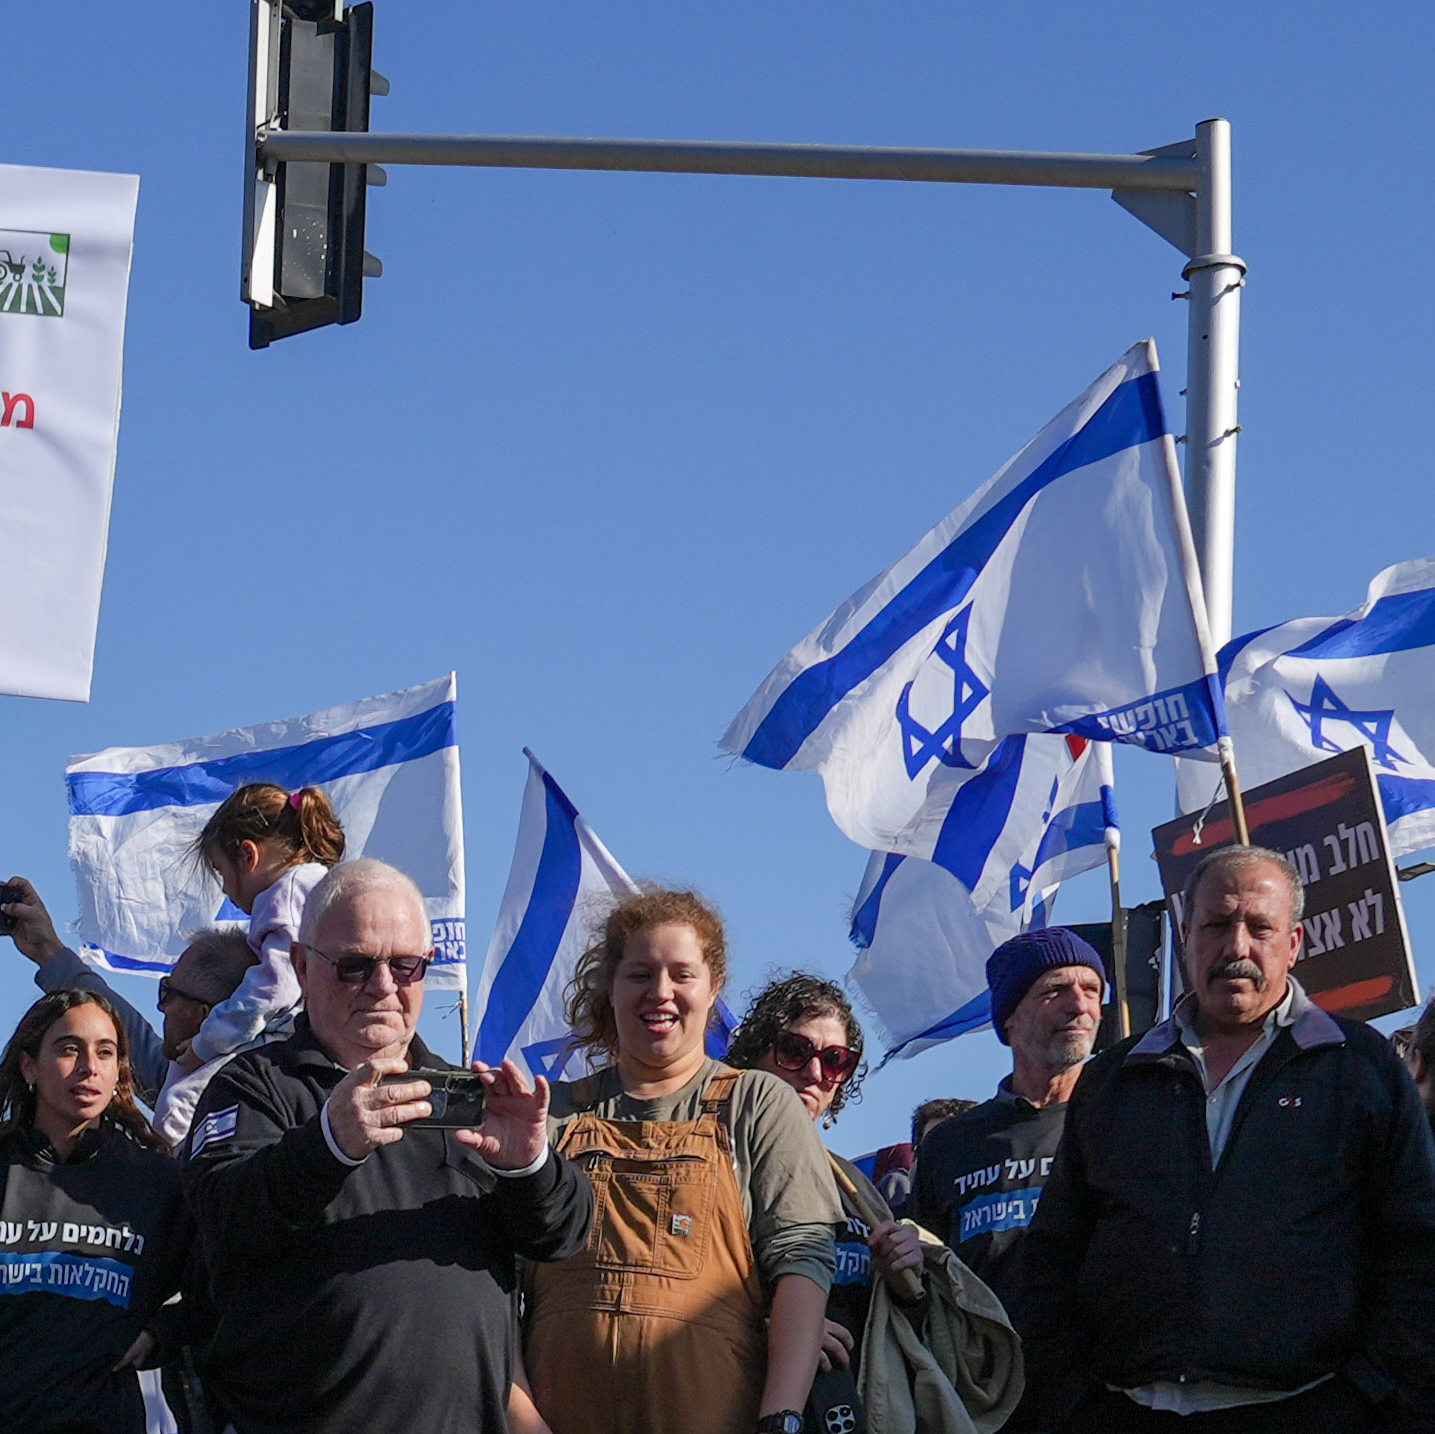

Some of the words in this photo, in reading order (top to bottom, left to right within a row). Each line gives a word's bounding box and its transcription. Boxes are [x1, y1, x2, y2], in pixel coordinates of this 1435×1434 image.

[1097, 692, 1190, 735] חופשי
[1323, 820, 1381, 877] חלב
[432, 921, 466, 942] חופ
[1348, 888, 1385, 943] לא
[1297, 908, 1346, 962] אצ
[954, 1163, 1001, 1196] עתיד
[1004, 1157, 1036, 1180] על
[26, 1219, 58, 1242] על
[964, 1199, 1027, 1232] בישראל
[61, 1222, 145, 1256] נלחמים
[47, 1262, 130, 1297] החקלאות
